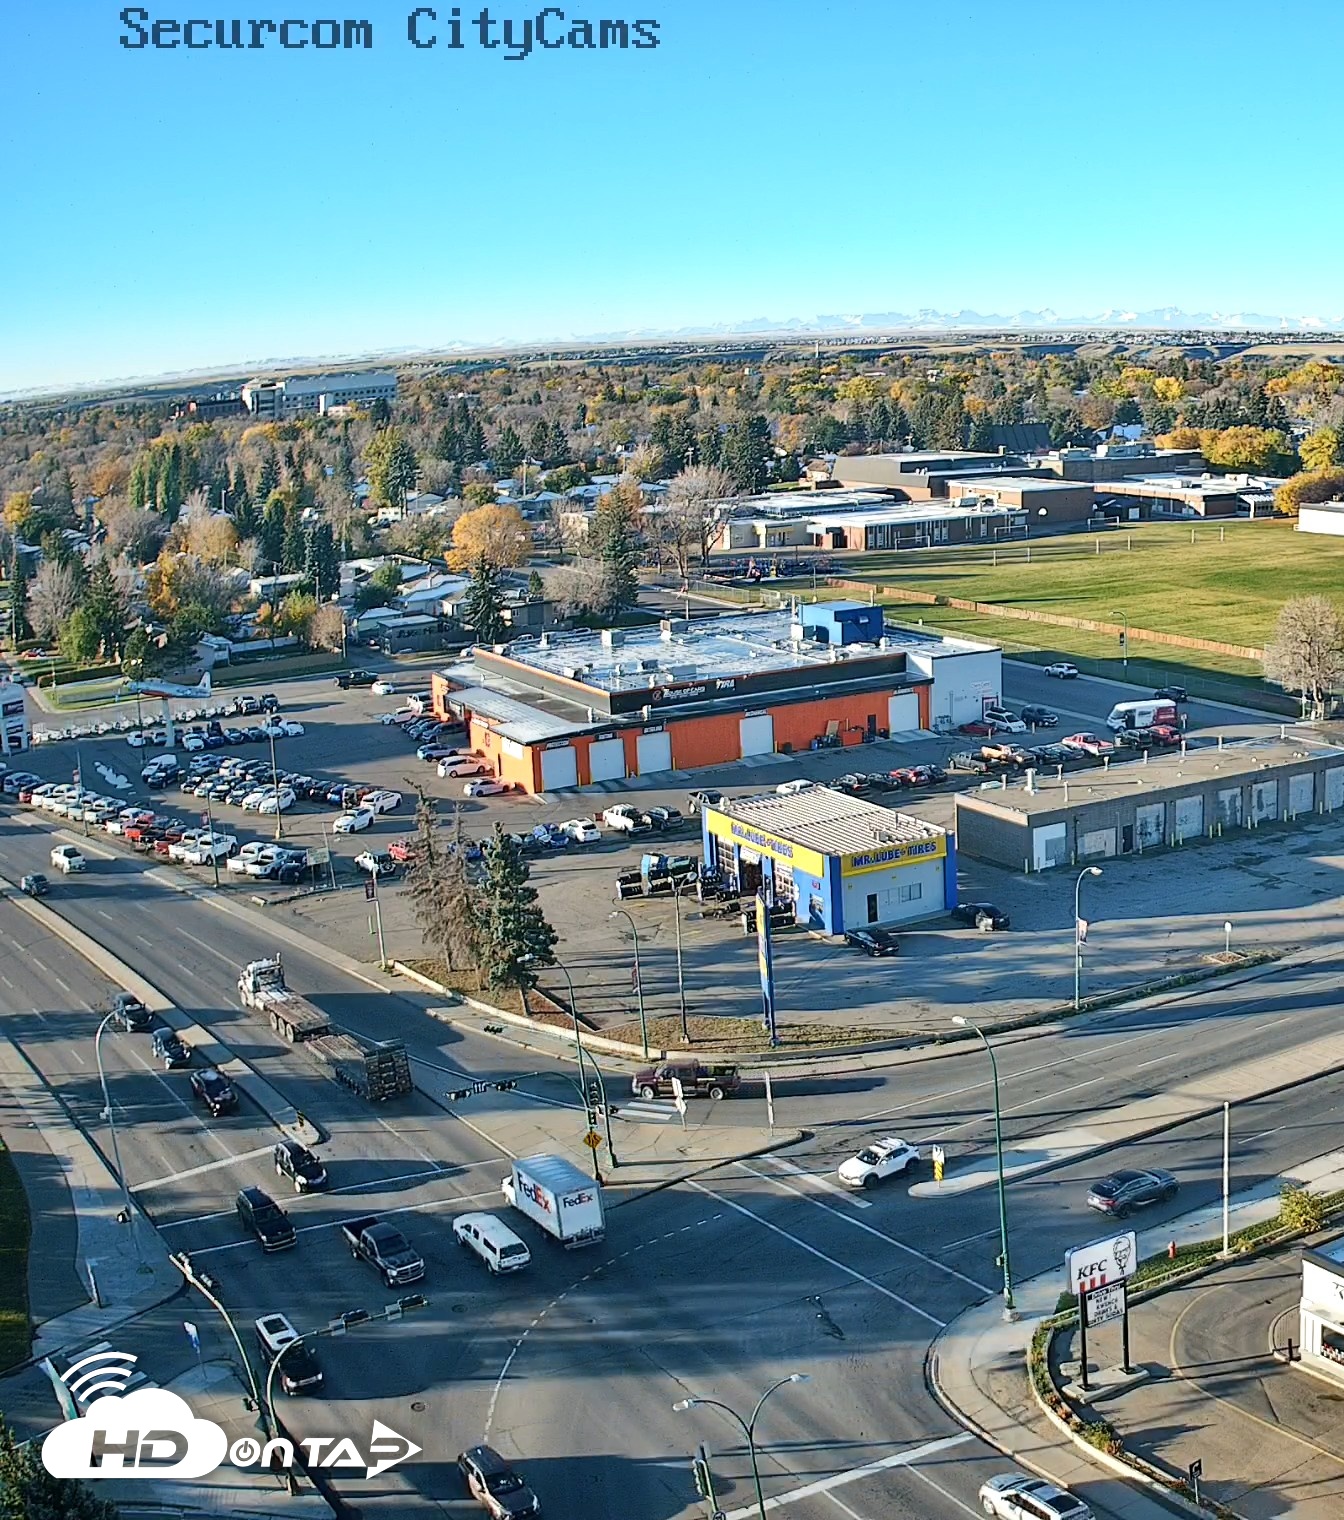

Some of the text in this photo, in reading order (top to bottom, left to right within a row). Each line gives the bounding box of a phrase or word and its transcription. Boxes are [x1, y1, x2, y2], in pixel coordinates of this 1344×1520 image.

[852, 854, 875, 868] MR.
[874, 848, 901, 864] LUBE
[907, 841, 937, 857] TIRES
[517, 1172, 552, 1214] FedEx
[563, 1192, 593, 1209] FedEx
[1077, 1259, 1108, 1281] KFC
